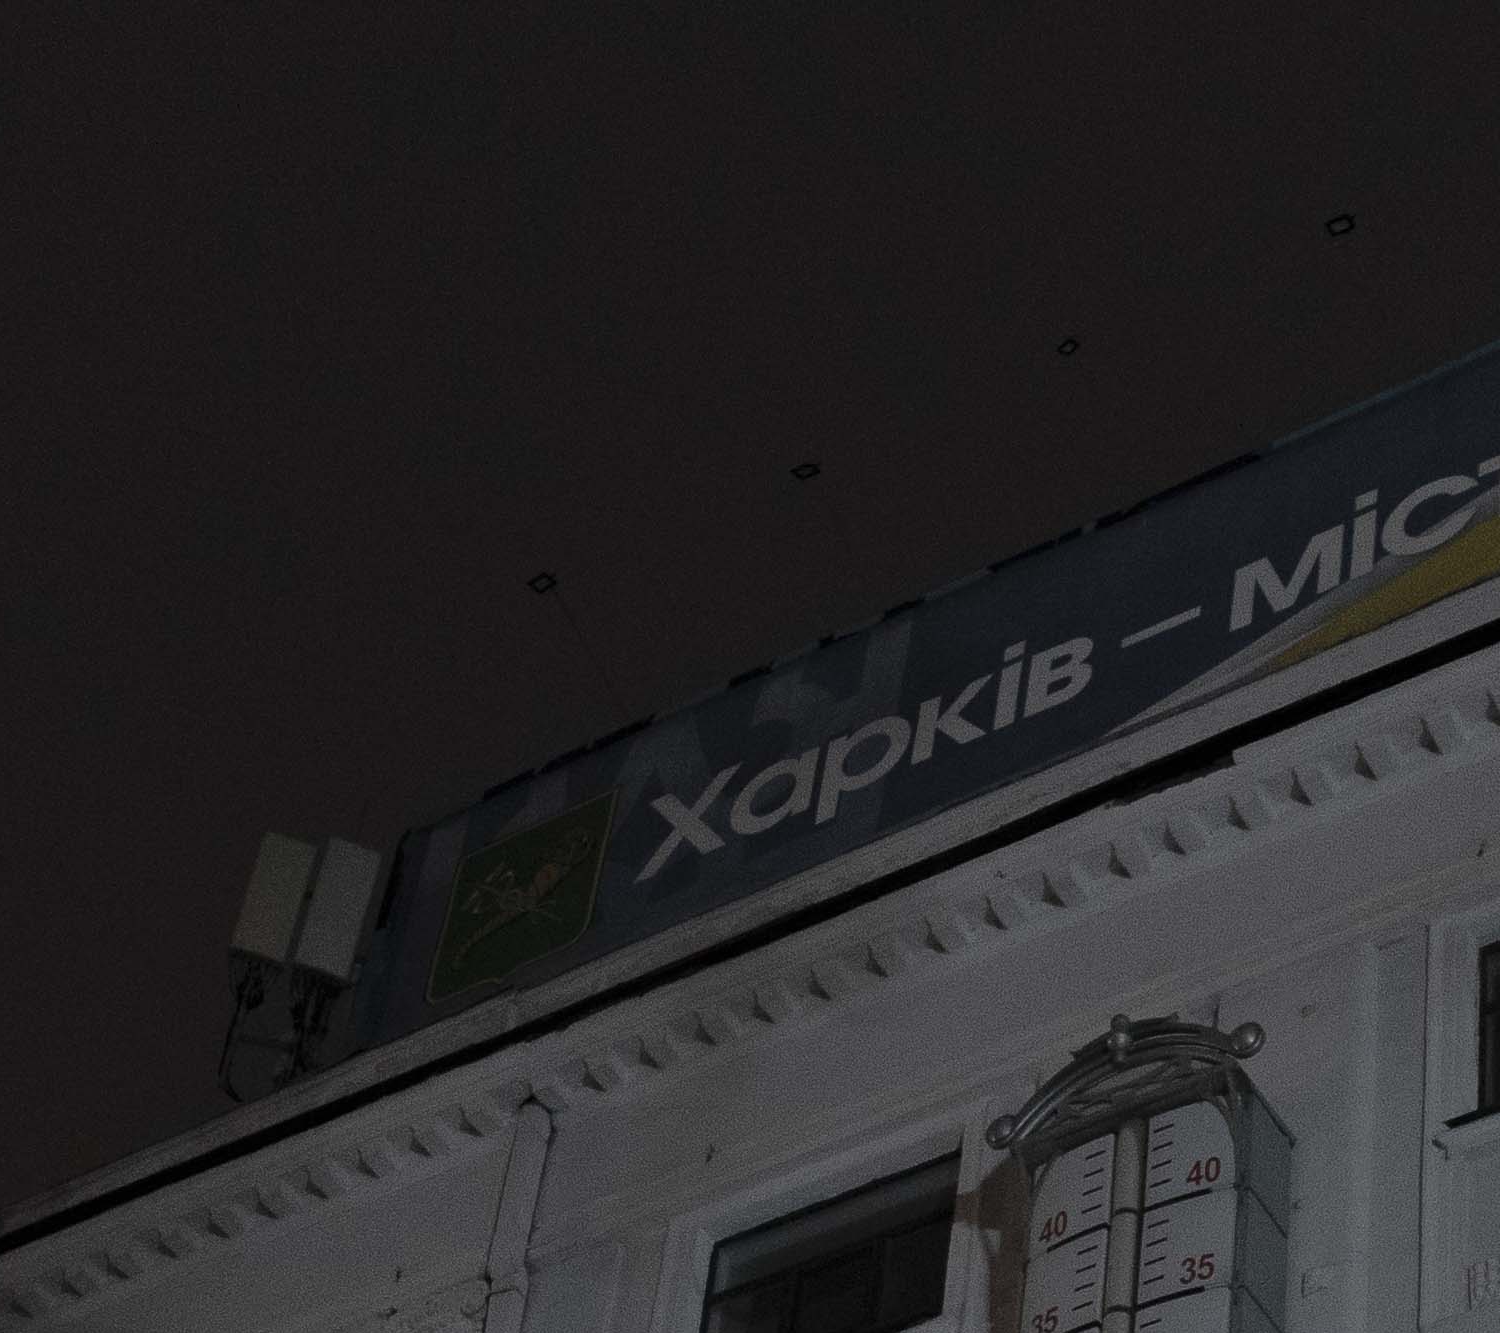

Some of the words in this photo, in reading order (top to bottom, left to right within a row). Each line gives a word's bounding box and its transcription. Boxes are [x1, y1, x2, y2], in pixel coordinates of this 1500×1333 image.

[634, 638, 1094, 884] Харків
[1187, 1157, 1221, 1185] 40
[1040, 1211, 1068, 1242] 40
[1180, 1254, 1215, 1284] 35
